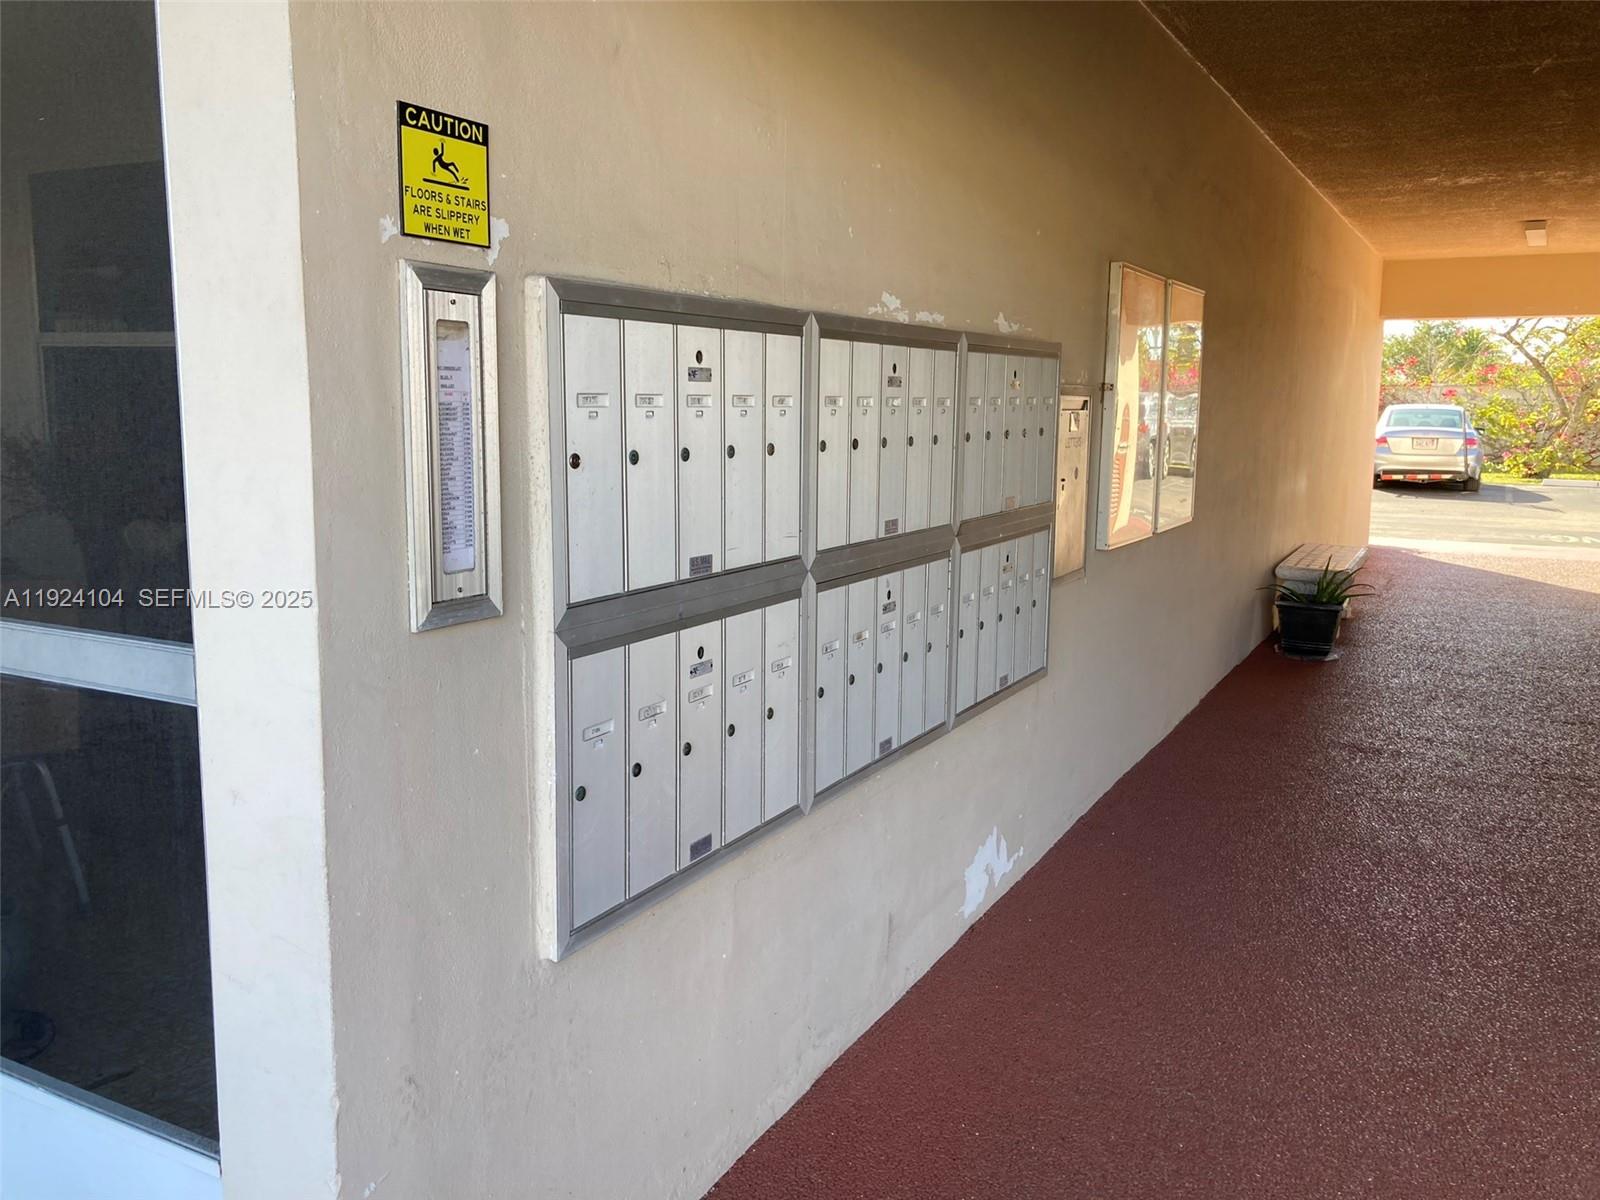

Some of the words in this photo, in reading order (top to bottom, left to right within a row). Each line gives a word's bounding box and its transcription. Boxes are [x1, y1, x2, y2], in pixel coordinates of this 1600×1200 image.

[405, 107, 483, 143] CAUTION
[404, 185, 444, 203] FLOORS
[445, 194, 452, 205] &
[454, 195, 487, 212] STAIRS
[412, 204, 432, 218] ARE
[435, 208, 480, 226] SLIPPERY
[423, 222, 451, 237] WHEN
[452, 227, 471, 240] WET
